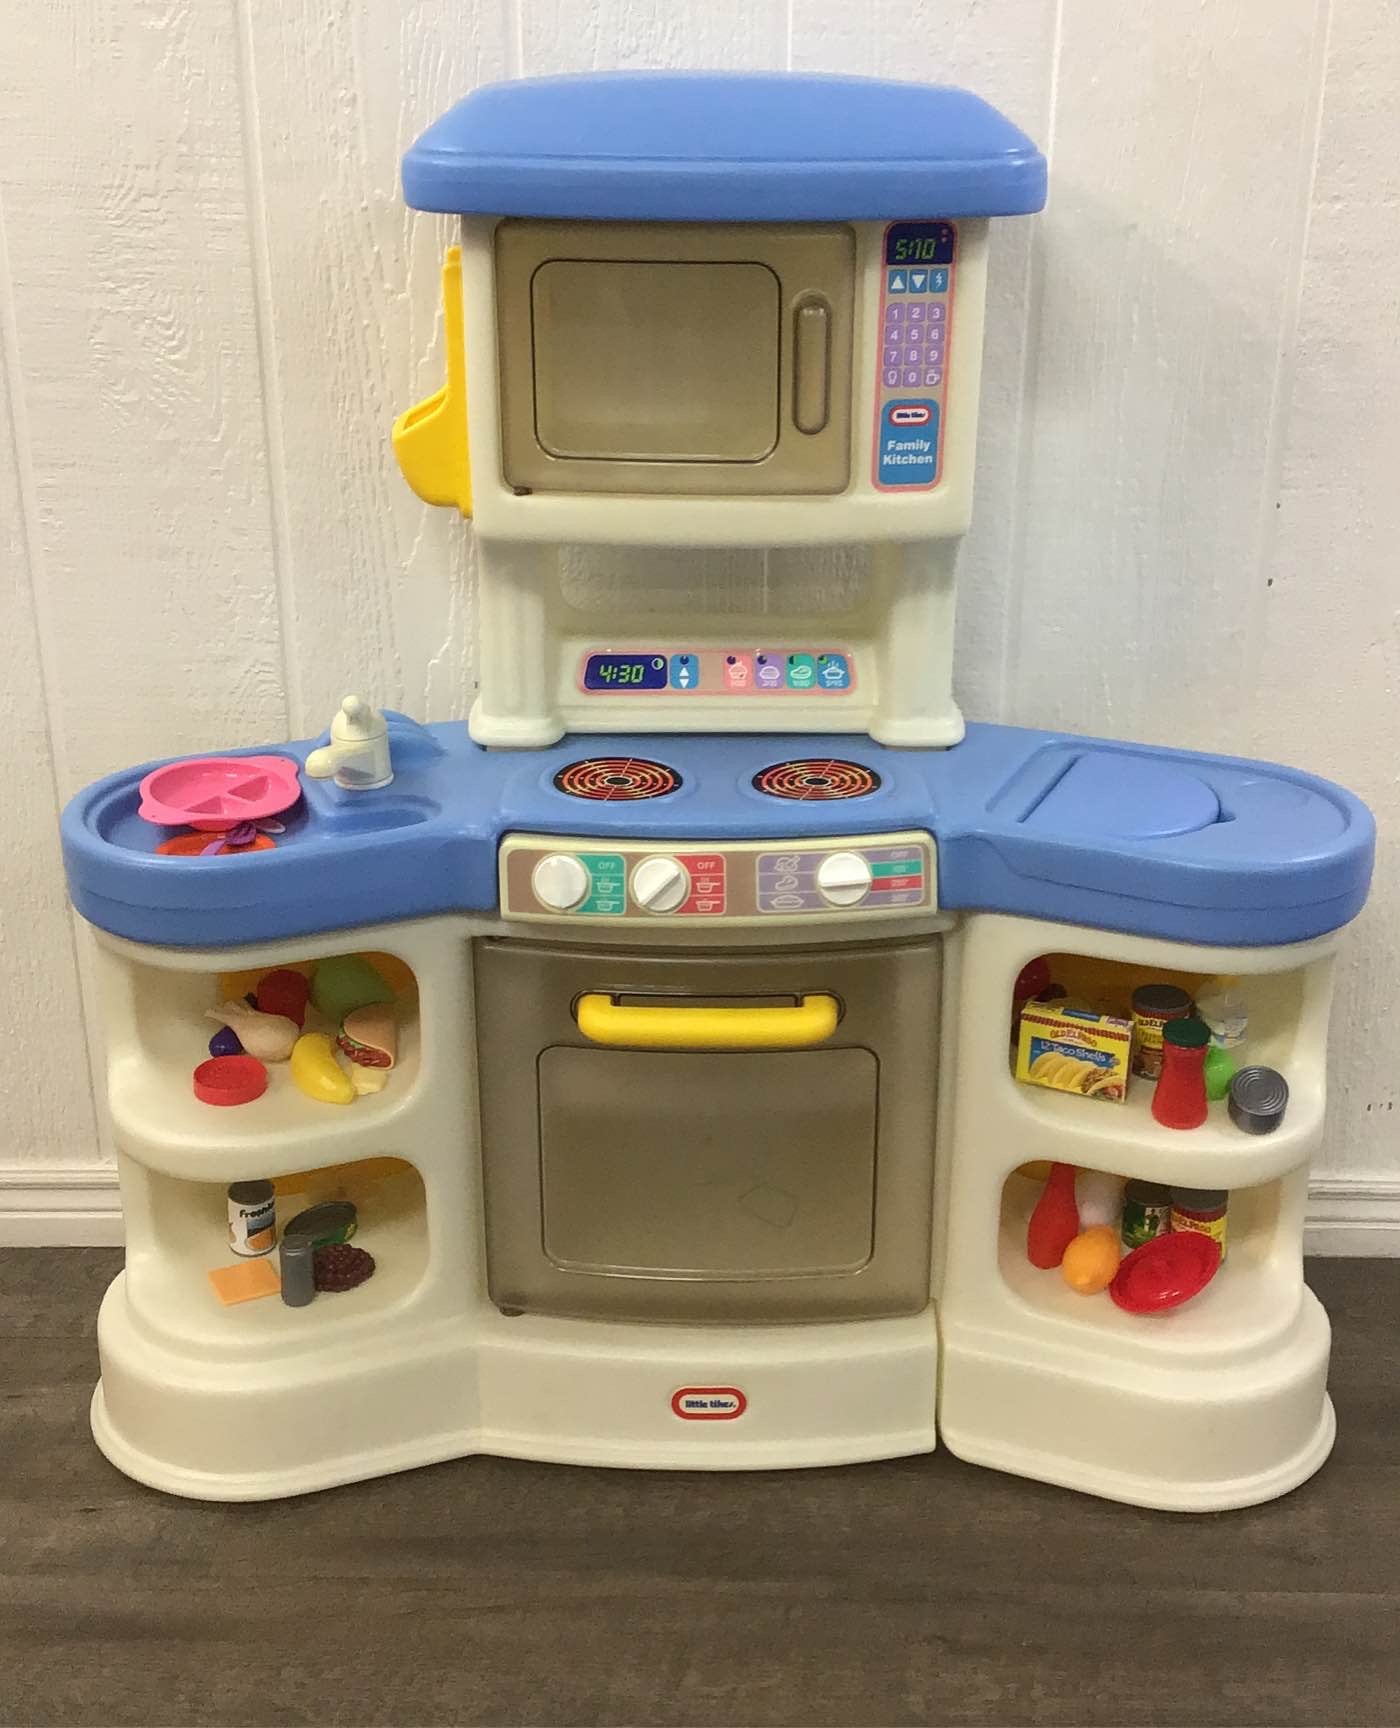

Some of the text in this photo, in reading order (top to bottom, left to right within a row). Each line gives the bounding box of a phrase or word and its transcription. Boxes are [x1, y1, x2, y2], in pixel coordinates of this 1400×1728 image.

[911, 307, 921, 319] 2
[932, 307, 941, 319] 3
[890, 328, 940, 341] 4 5 6
[889, 350, 939, 362] 7 8 9
[908, 372, 917, 383] 0
[887, 439, 931, 452] Family
[882, 454, 933, 465] Kitchen
[599, 664, 645, 684] 4:30
[697, 861, 715, 870] OFF
[1052, 1042, 1075, 1056] Taco
[1075, 1047, 1106, 1062] Shells
[685, 1400, 708, 1408] little
